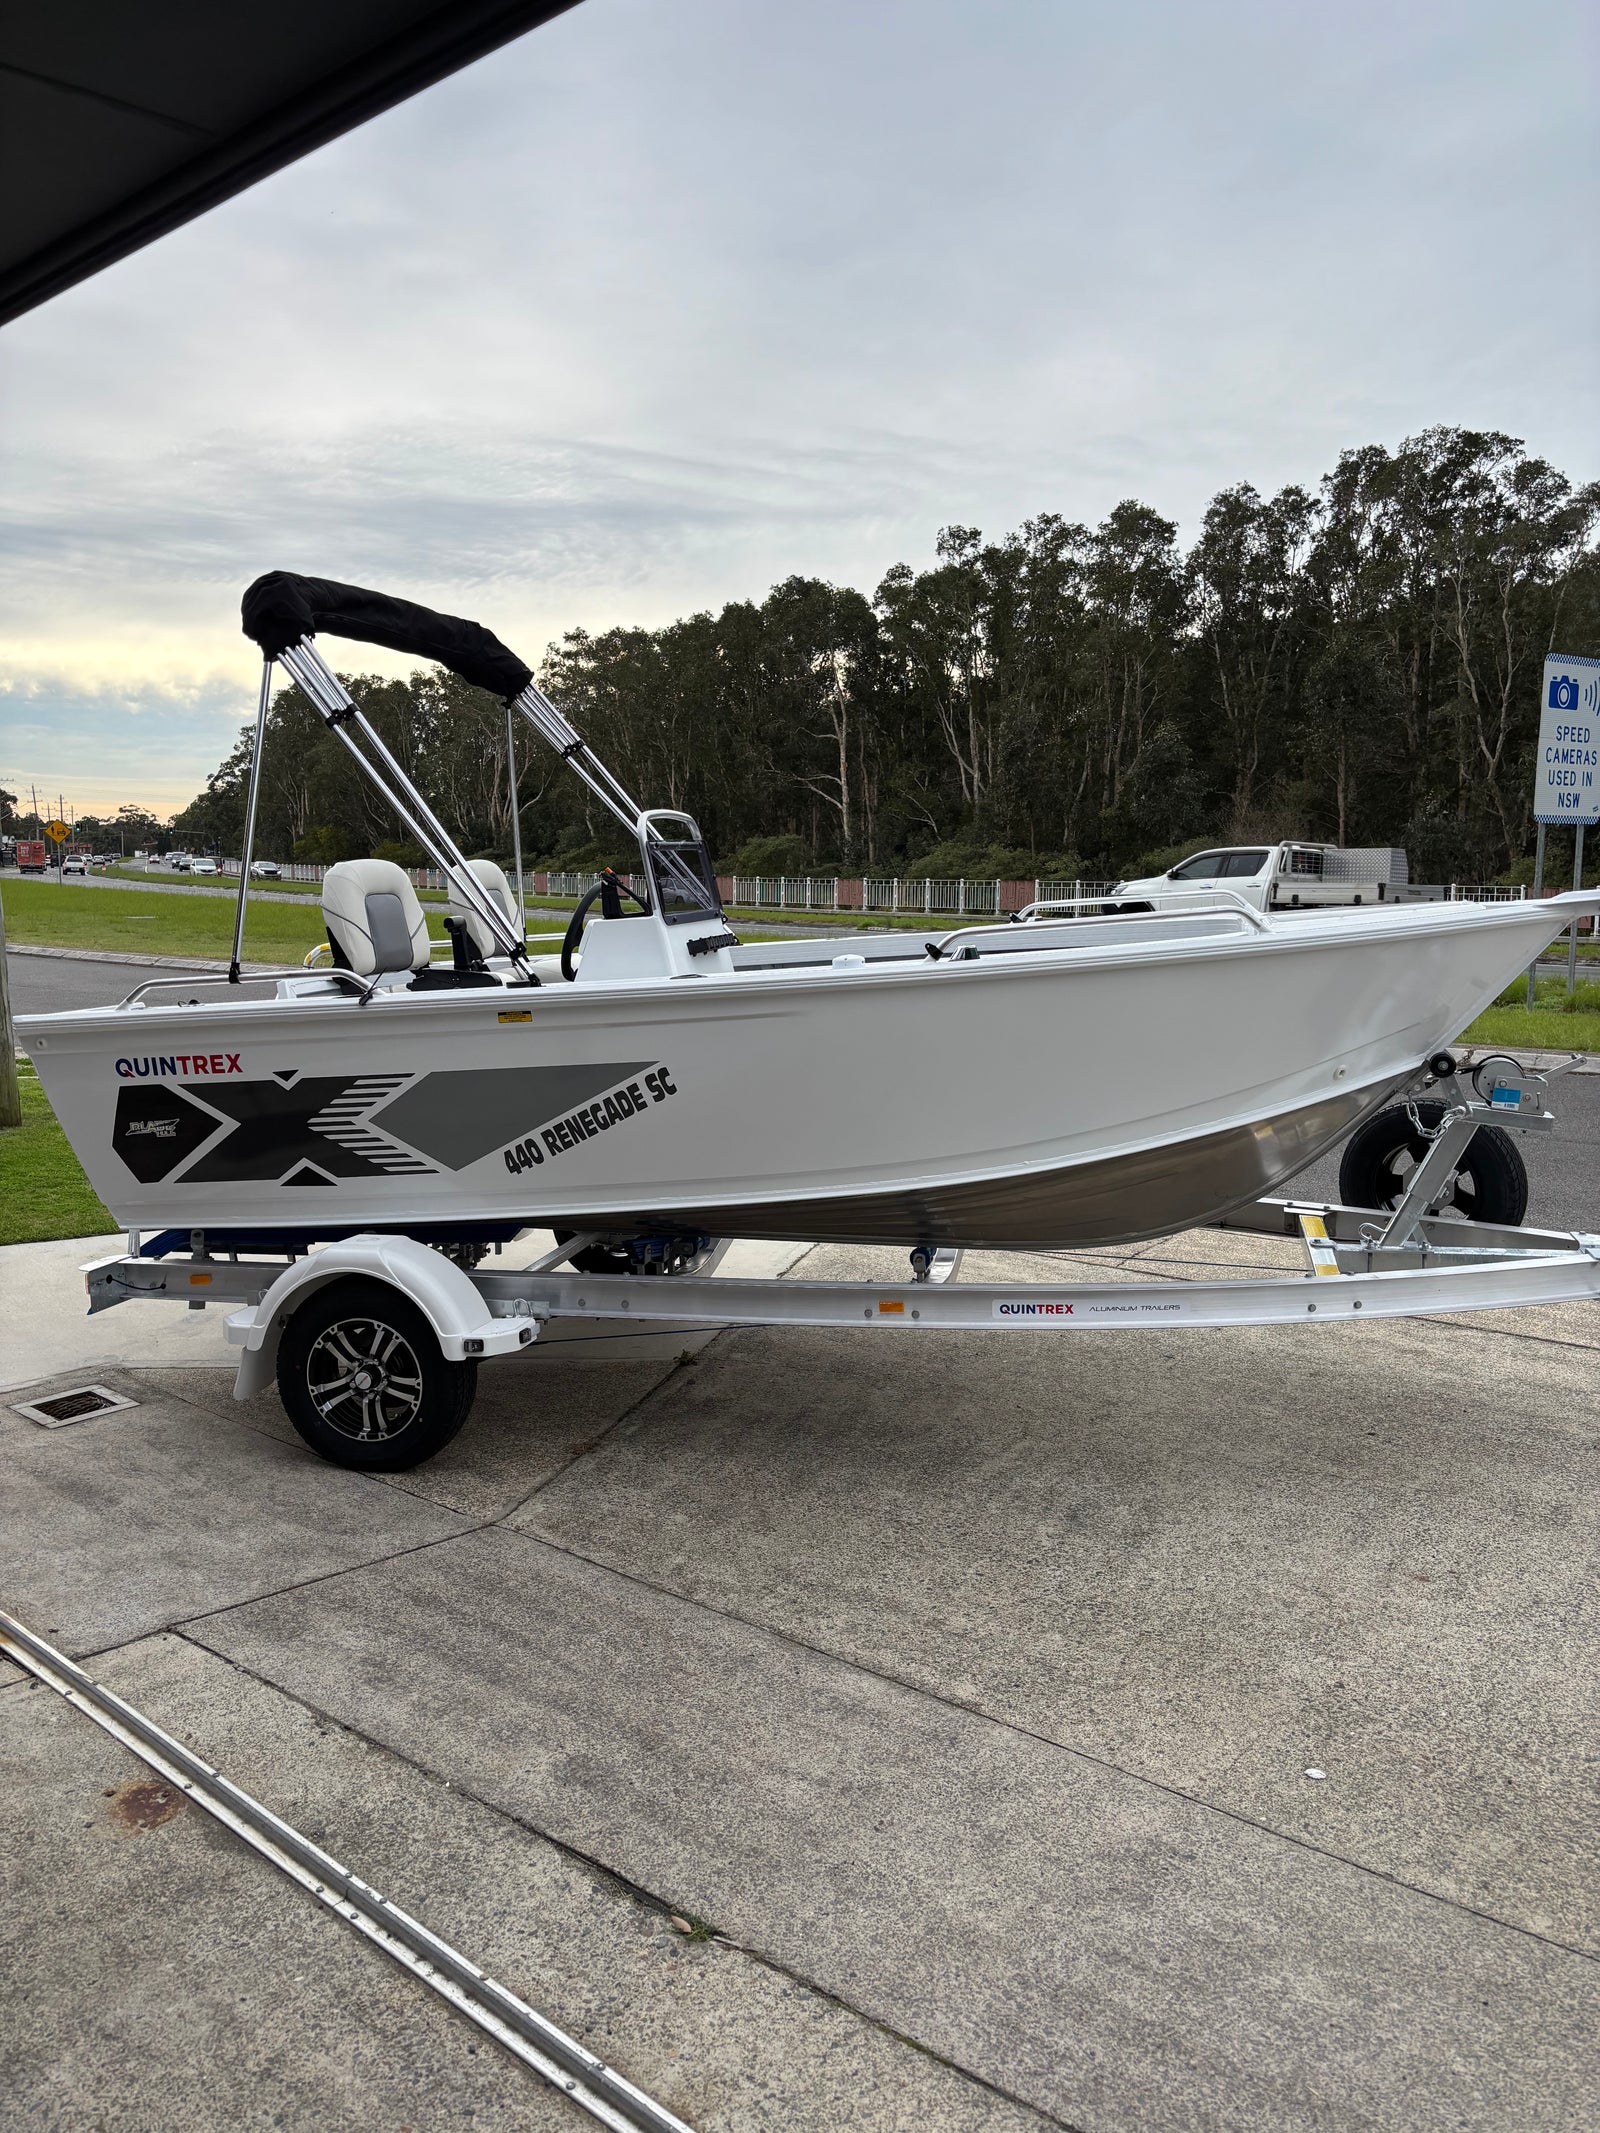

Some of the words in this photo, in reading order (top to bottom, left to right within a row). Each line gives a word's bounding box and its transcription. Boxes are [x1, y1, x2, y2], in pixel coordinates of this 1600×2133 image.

[1556, 725, 1590, 743] SPEED
[1546, 747, 1598, 766] CAMERAS
[1548, 769, 1577, 787] USED
[1582, 771, 1593, 787] IN
[1557, 792, 1581, 809] NSW
[115, 1053, 244, 1078] QUINTREX
[503, 1138, 545, 1175] 440
[540, 1082, 649, 1157] RENEGADE
[645, 1066, 678, 1103] SC
[1000, 1304, 1074, 1315] QUINTREX
